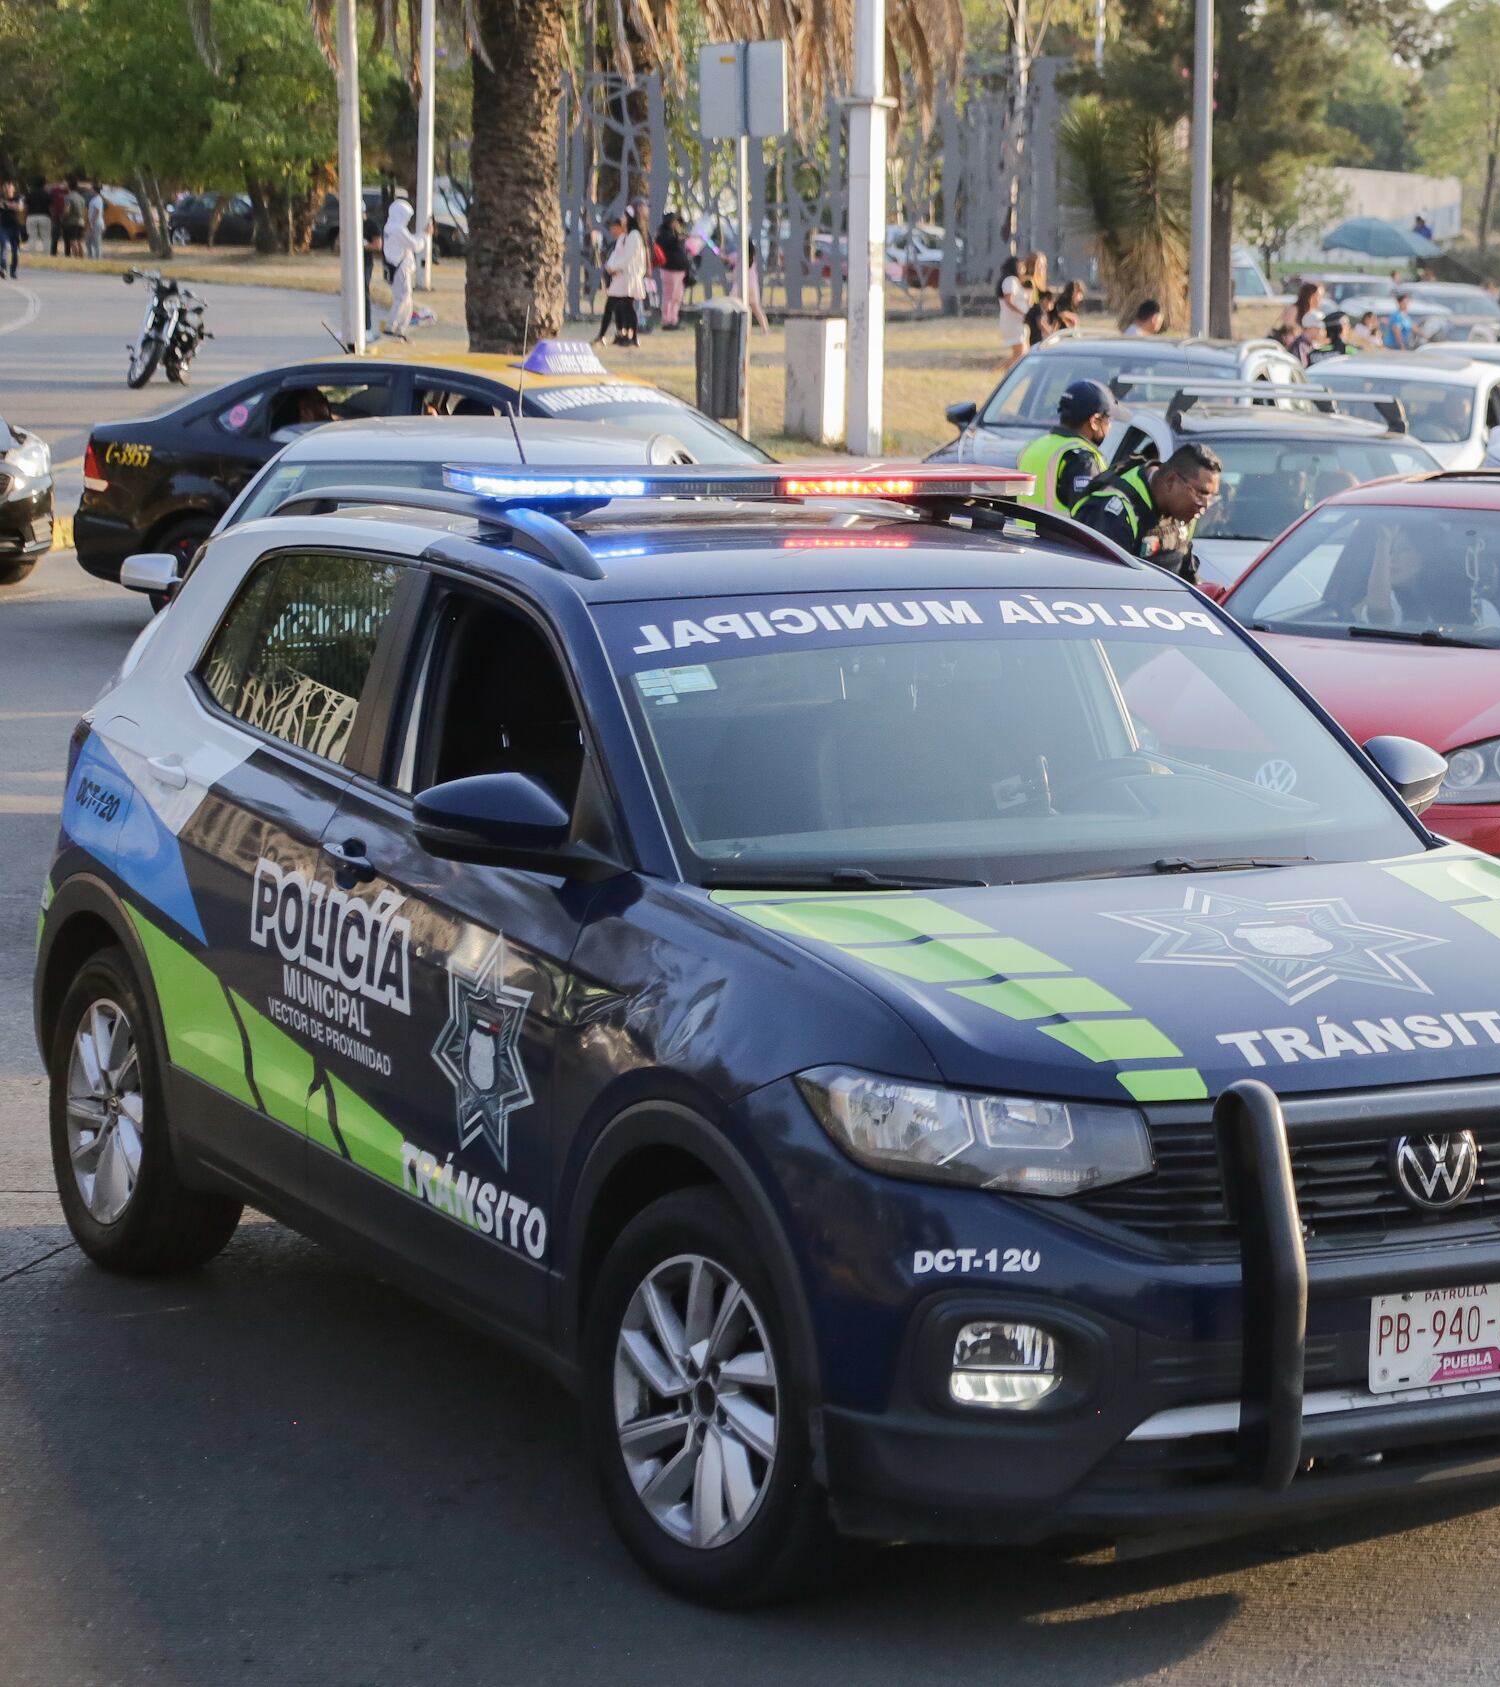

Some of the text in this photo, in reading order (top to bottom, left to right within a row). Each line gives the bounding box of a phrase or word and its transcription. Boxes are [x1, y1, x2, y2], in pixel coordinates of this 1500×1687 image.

[250, 857, 412, 1016] POLICÍA
[268, 996, 392, 1077] VECTOR DE PROXIMIDAD
[283, 963, 371, 1037] MUNICIPAL
[400, 1140, 547, 1260] TRÁNSITO
[913, 1247, 1041, 1274] DCT-120
[1424, 1284, 1488, 1303] PATRULLA
[1443, 1351, 1493, 1371] PUEBLA
